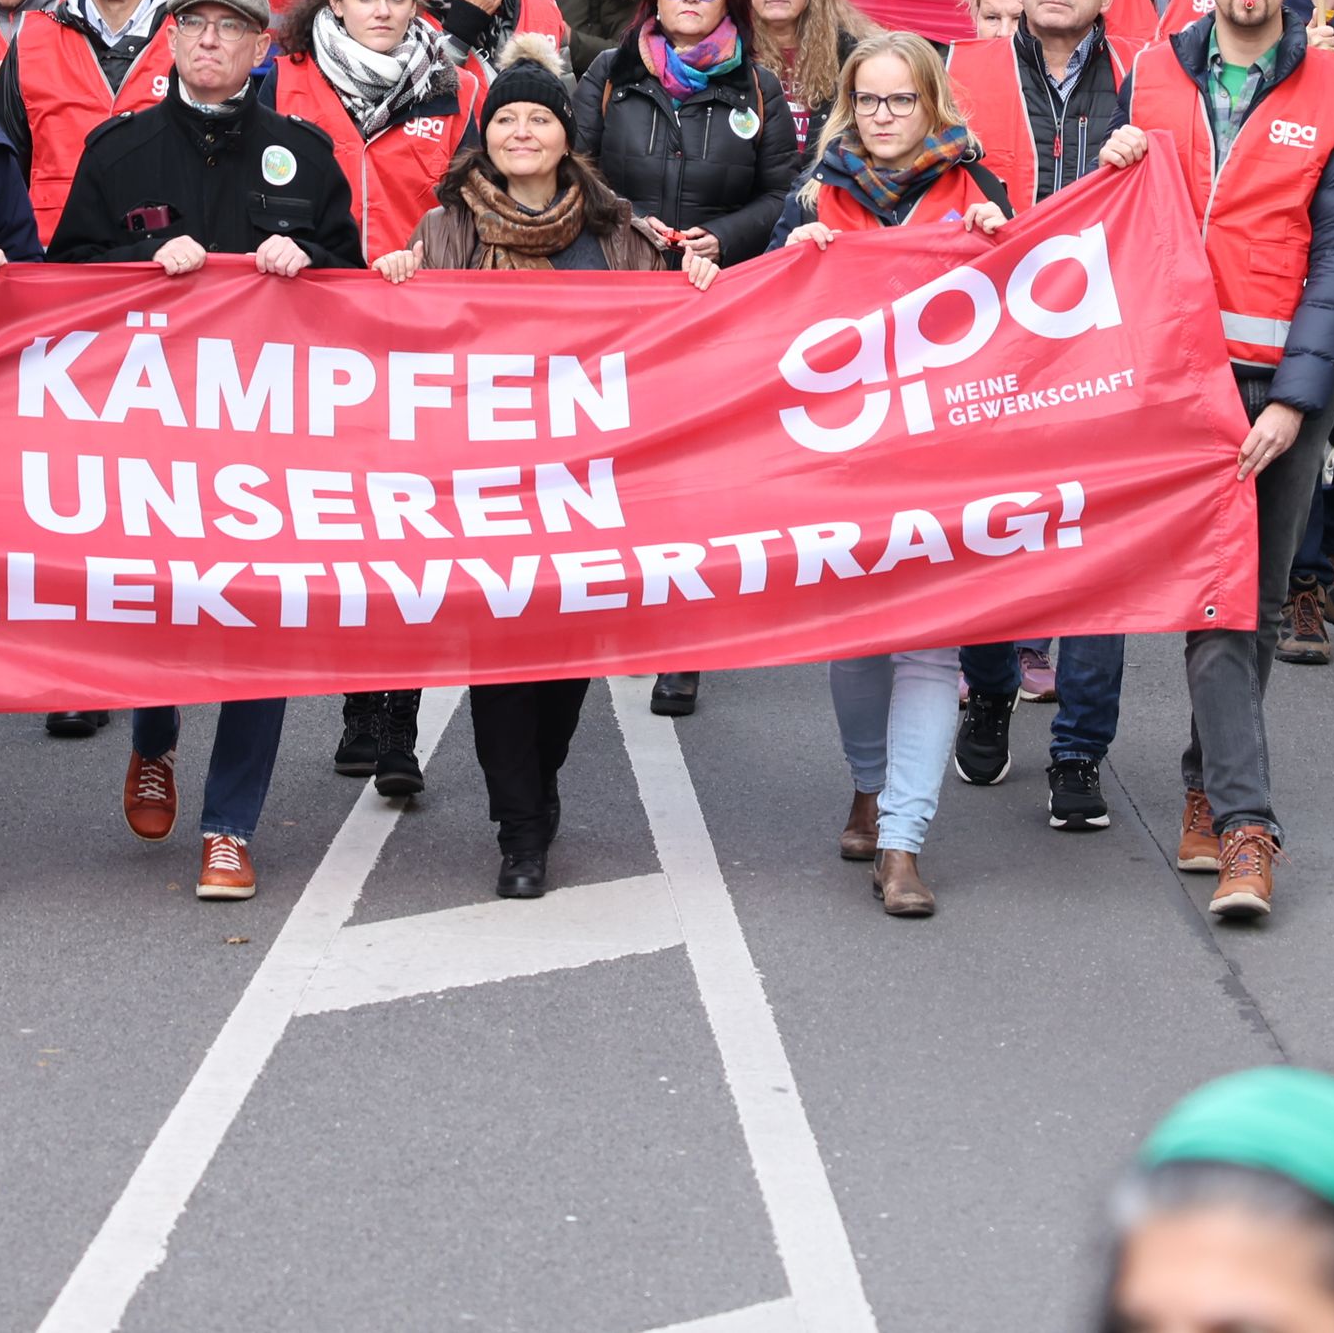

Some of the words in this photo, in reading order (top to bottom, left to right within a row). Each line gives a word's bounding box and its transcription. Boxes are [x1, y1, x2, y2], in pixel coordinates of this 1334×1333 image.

[402, 118, 445, 140] gpa
[1268, 119, 1317, 145] gpa
[777, 221, 1123, 453] gpa
[17, 310, 630, 441] KÄMPFEN
[944, 373, 1019, 405] MEINE
[948, 369, 1135, 427] GEWERKSCHAFT
[22, 451, 627, 542] UNSEREN
